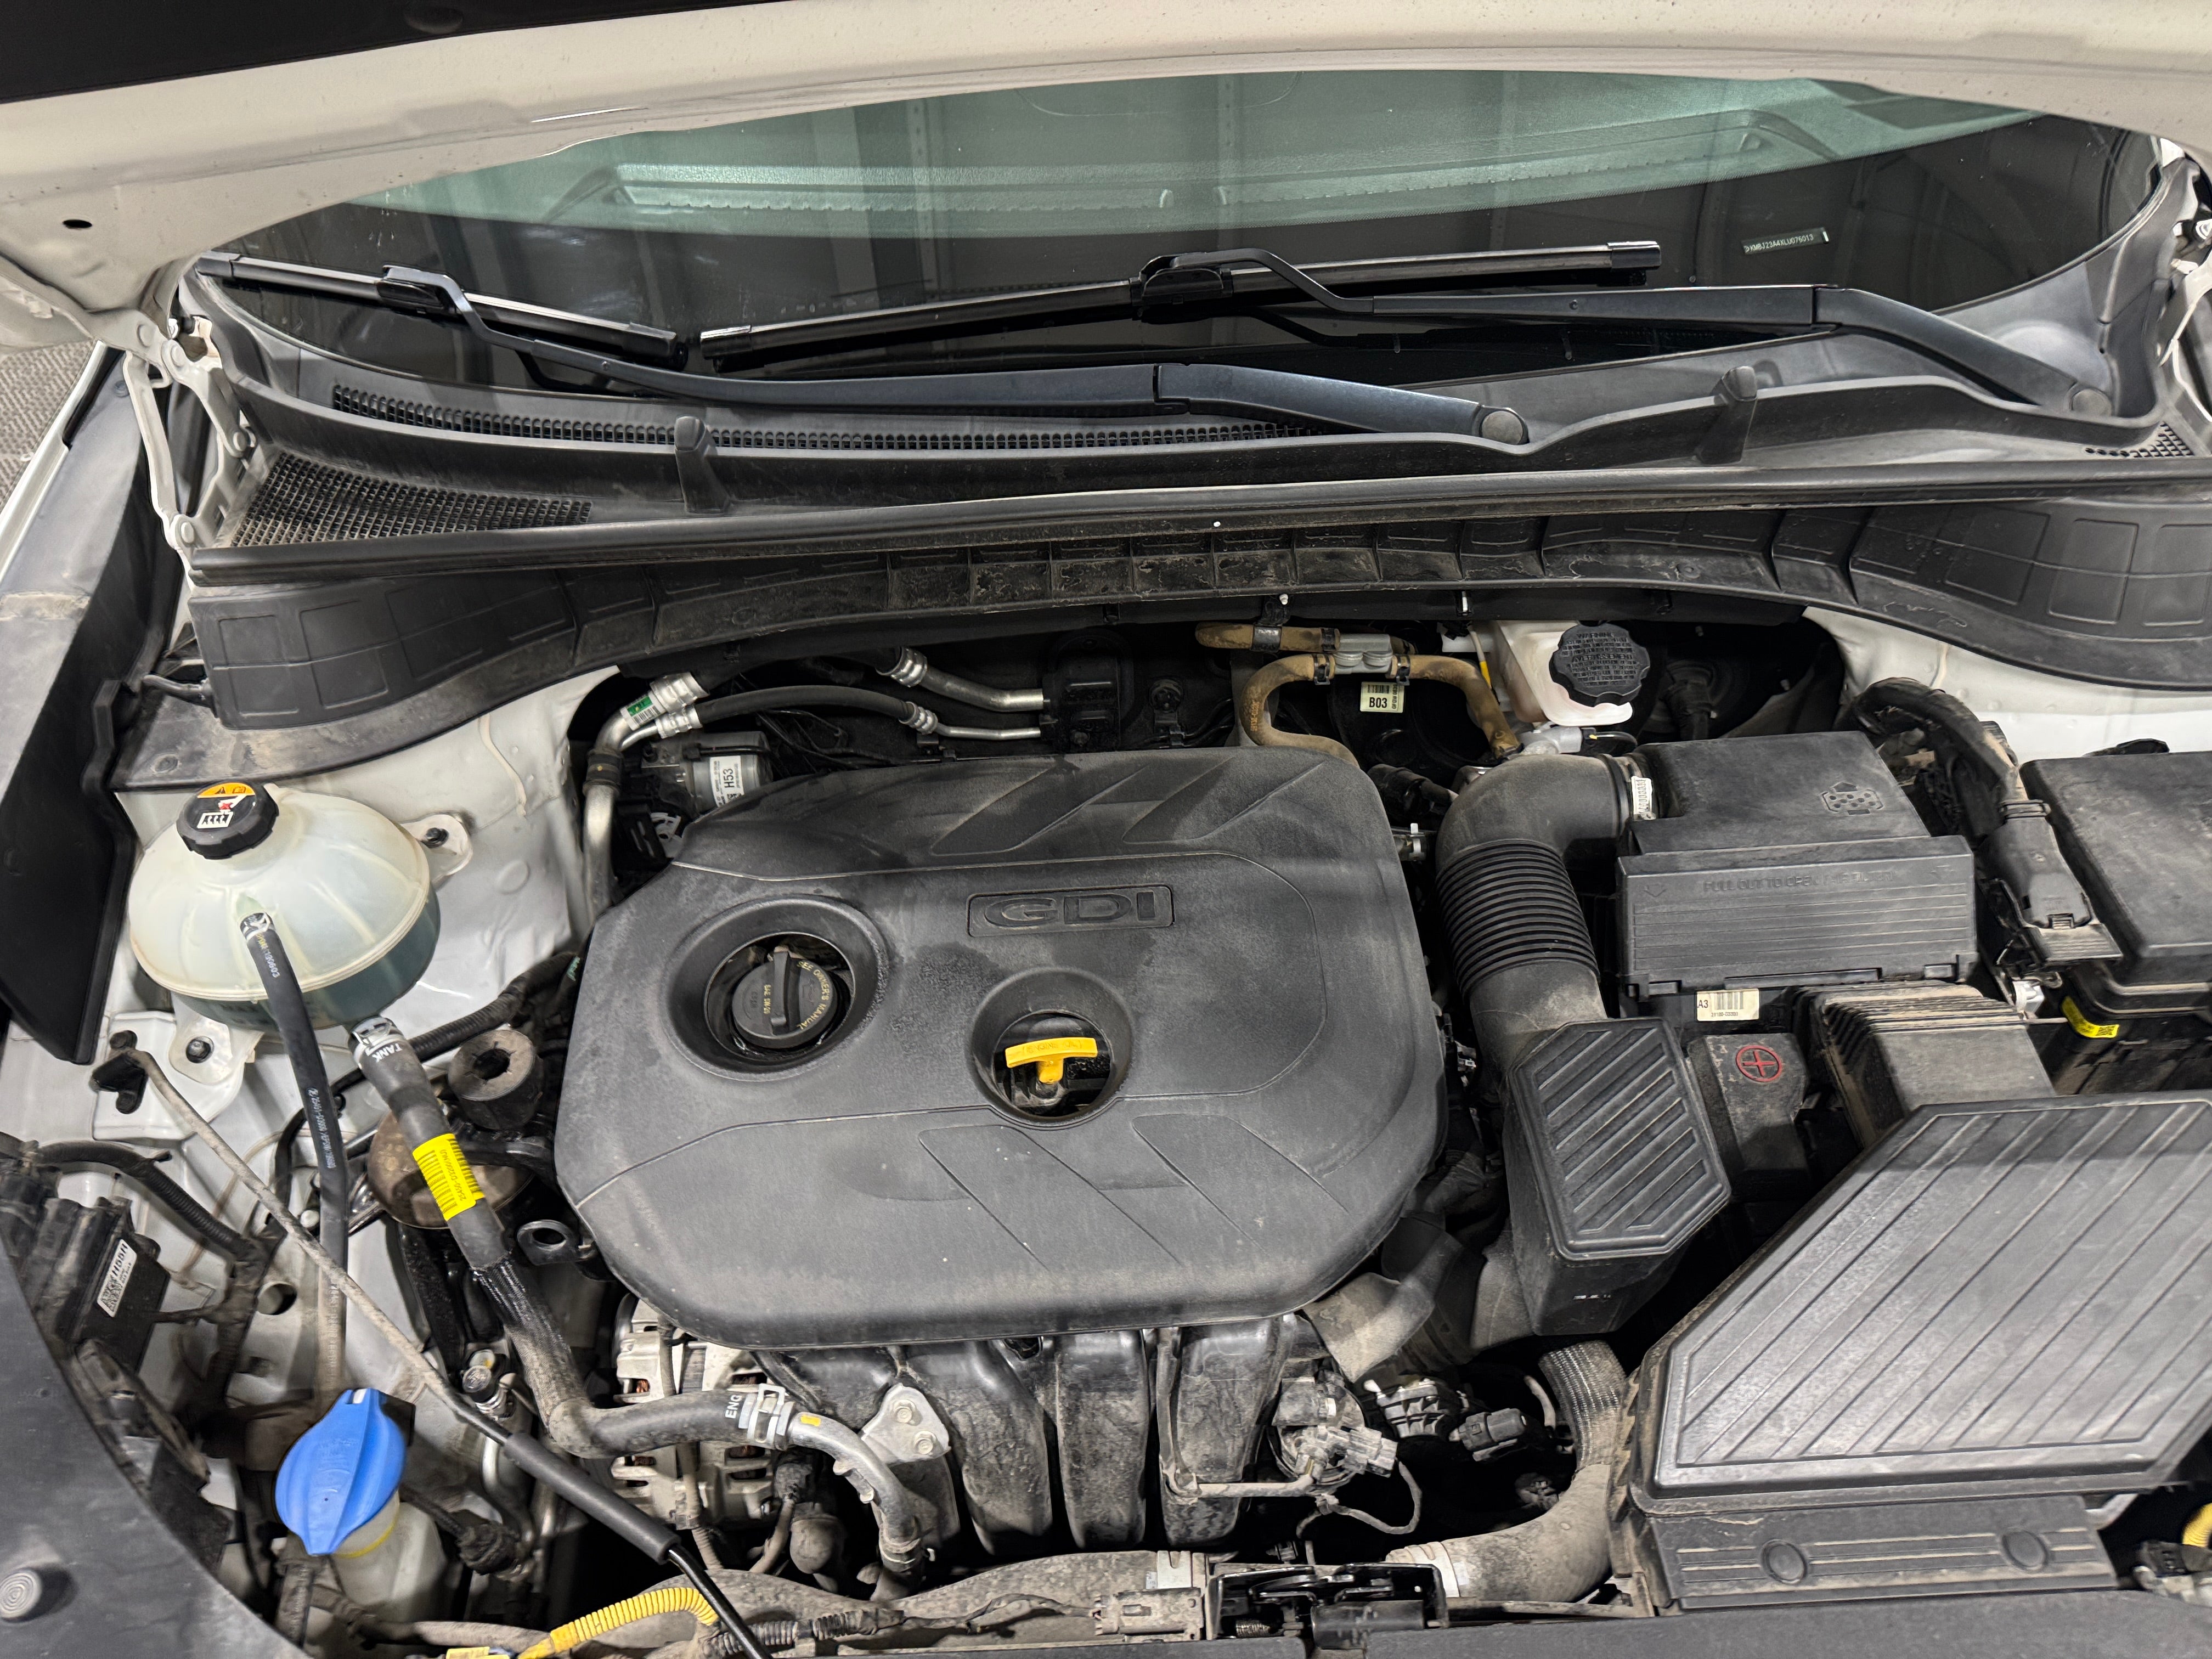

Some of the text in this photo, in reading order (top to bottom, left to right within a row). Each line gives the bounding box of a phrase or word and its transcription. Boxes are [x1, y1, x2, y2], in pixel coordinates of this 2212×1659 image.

[1369, 697, 1387, 708] B03
[724, 768, 734, 789] H53
[1703, 879, 1735, 892] PULL
[1737, 878, 1762, 890] OUT
[1763, 877, 1784, 889] TO
[1786, 874, 1818, 887] OPEN
[984, 890, 1156, 929] GDI
[796, 961, 831, 1030] SEE OWNER'S MANUAL
[1697, 1000, 1708, 1008] A3
[371, 1045, 402, 1063] TANK
